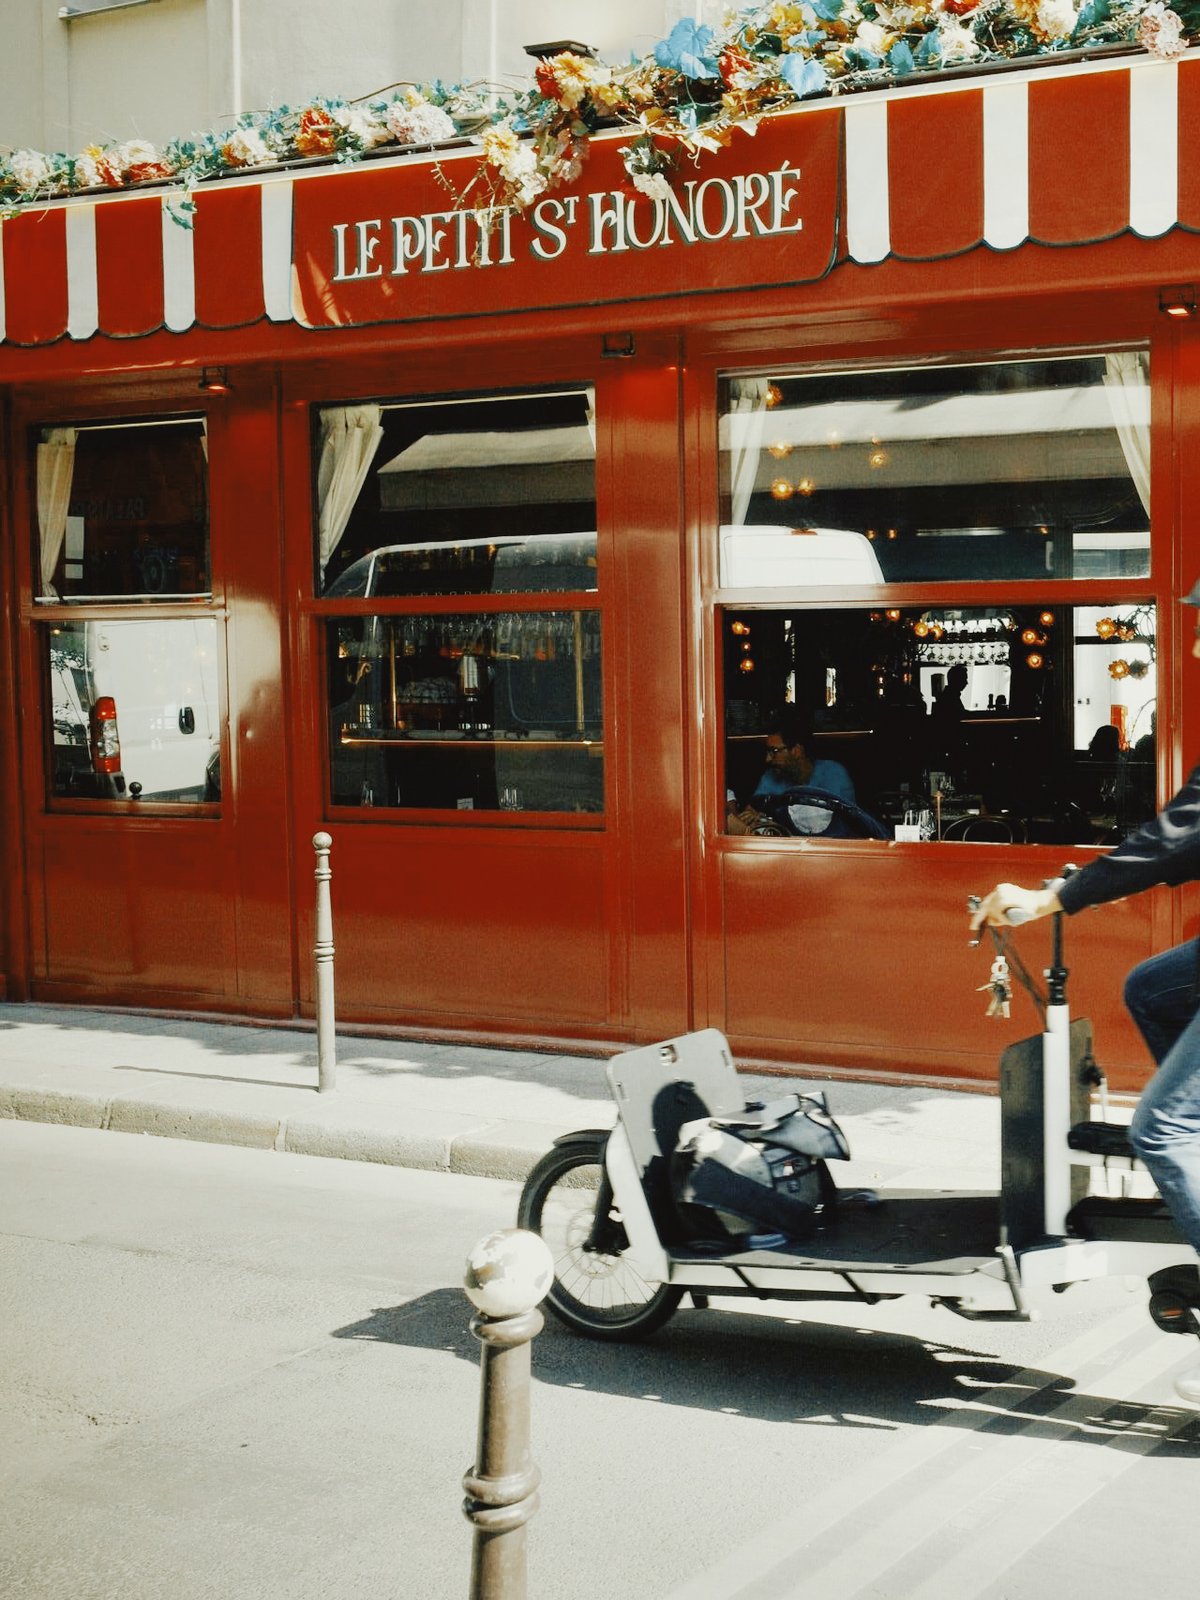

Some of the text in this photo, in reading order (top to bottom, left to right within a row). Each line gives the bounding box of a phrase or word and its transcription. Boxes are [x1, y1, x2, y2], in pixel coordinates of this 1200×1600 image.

[331, 219, 383, 281] LE
[391, 204, 525, 275] PETIT
[588, 159, 803, 254] HONORÉ
